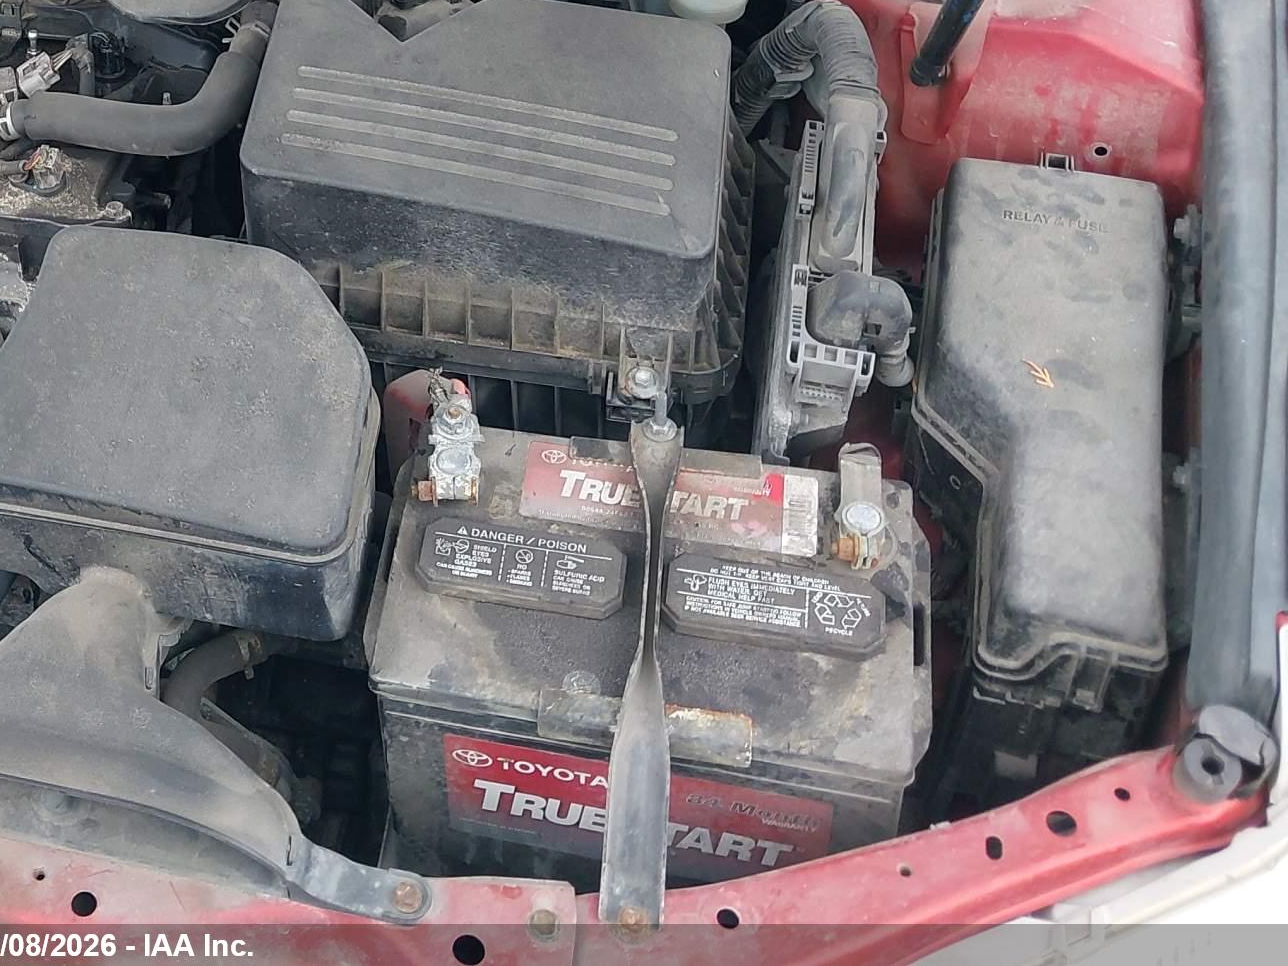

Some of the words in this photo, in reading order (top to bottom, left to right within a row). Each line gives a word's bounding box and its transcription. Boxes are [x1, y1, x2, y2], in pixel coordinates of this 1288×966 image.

[1003, 209, 1050, 226] RELAY
[470, 528, 525, 544] DANGER
[537, 538, 588, 554] POISON
[496, 756, 610, 789] TOYOTA
[473, 778, 607, 833] TRUE
